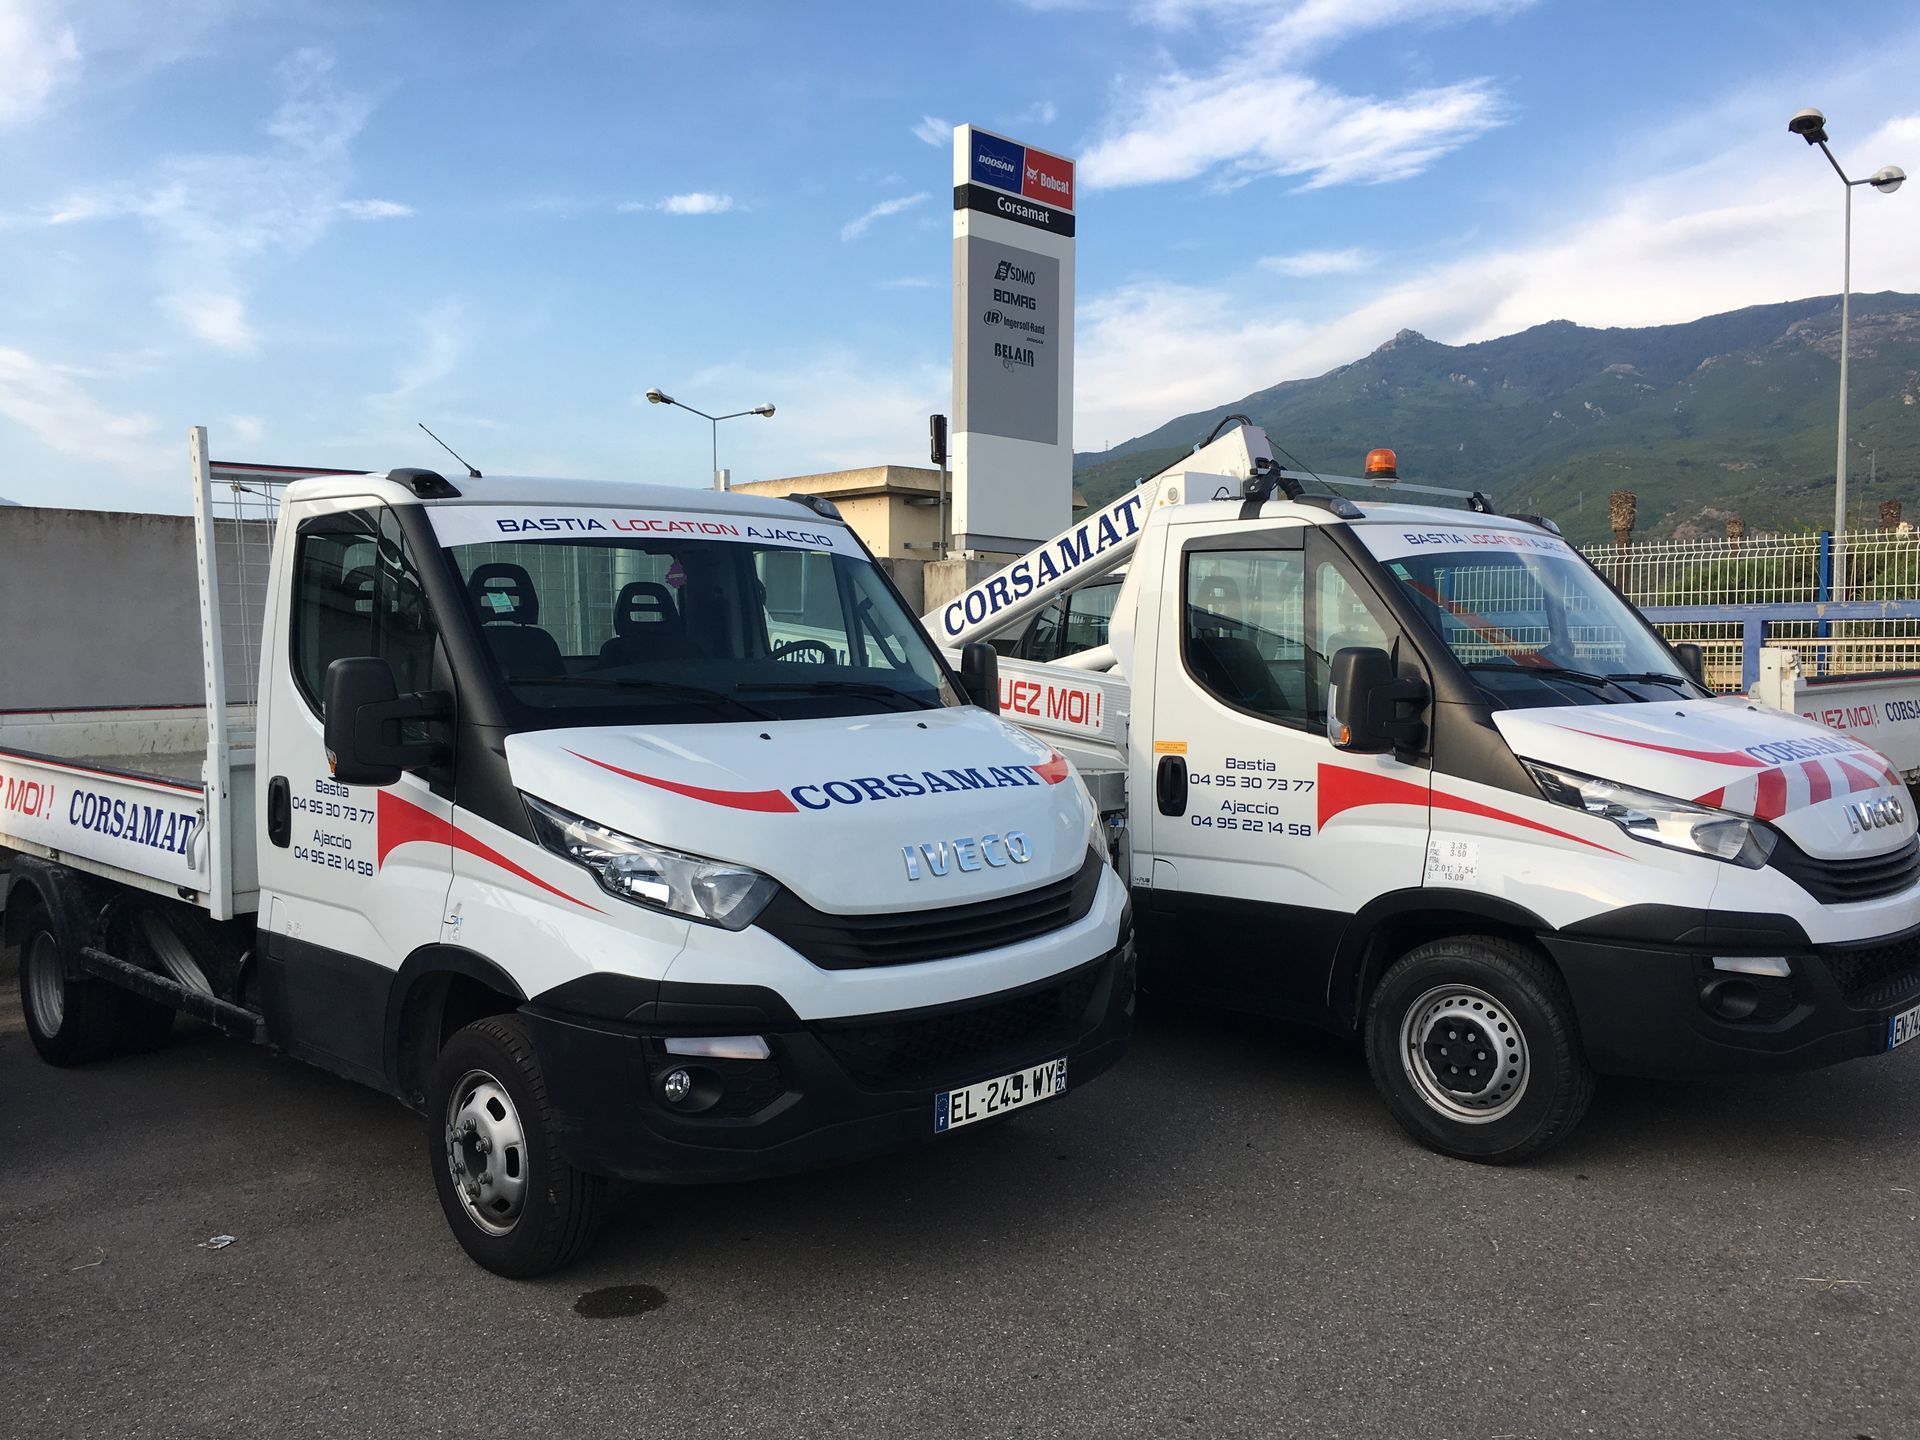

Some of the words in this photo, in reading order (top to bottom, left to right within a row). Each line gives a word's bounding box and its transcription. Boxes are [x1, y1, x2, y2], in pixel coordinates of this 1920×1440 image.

[978, 154, 1015, 173] DOOSAN
[1040, 172, 1070, 195] Bobcat
[997, 196, 1050, 224] Corsamat
[1010, 266, 1036, 285] SDMO
[993, 288, 1037, 310] BOMAG
[986, 311, 1000, 324] IR
[994, 342, 1034, 367] BELAIR
[496, 518, 607, 533] BASTIA
[611, 518, 739, 537] LOCATION
[747, 526, 834, 547] AJACCIO
[1403, 533, 1464, 545] BASTIA
[1466, 534, 1531, 548] LOCATION
[944, 494, 1142, 636] CORSAMAT
[1885, 699, 1920, 722] CORSA
[1225, 757, 1276, 772] Bastia
[315, 779, 349, 798] Bastia
[790, 765, 1040, 810] CORSAMAT
[1189, 773, 1211, 786] 04
[1215, 775, 1236, 788] 95
[1240, 776, 1262, 789] 30
[1266, 778, 1288, 791] 73
[1292, 779, 1314, 793] 77
[292, 796, 307, 811] 04
[309, 800, 323, 814] 95
[325, 803, 340, 818] 30
[343, 806, 357, 821] 73
[360, 809, 375, 824] 77
[1220, 800, 1279, 816] Ajaccio
[1842, 795, 1904, 835] IVECO
[69, 789, 197, 855] CORSAMAT
[1191, 814, 1213, 828] 04
[1217, 816, 1238, 830] 95
[1241, 818, 1263, 832] 22
[1267, 821, 1284, 835] 14
[1288, 823, 1312, 837] 58
[313, 829, 352, 850] Ajaccio
[294, 846, 308, 860] 04
[311, 849, 325, 864] 95
[327, 853, 342, 869] 22
[343, 857, 355, 872] 14
[357, 861, 374, 877] 58
[902, 830, 1033, 882] IVECO
[1895, 1009, 1920, 1045] EN-74
[939, 1116, 945, 1126] F
